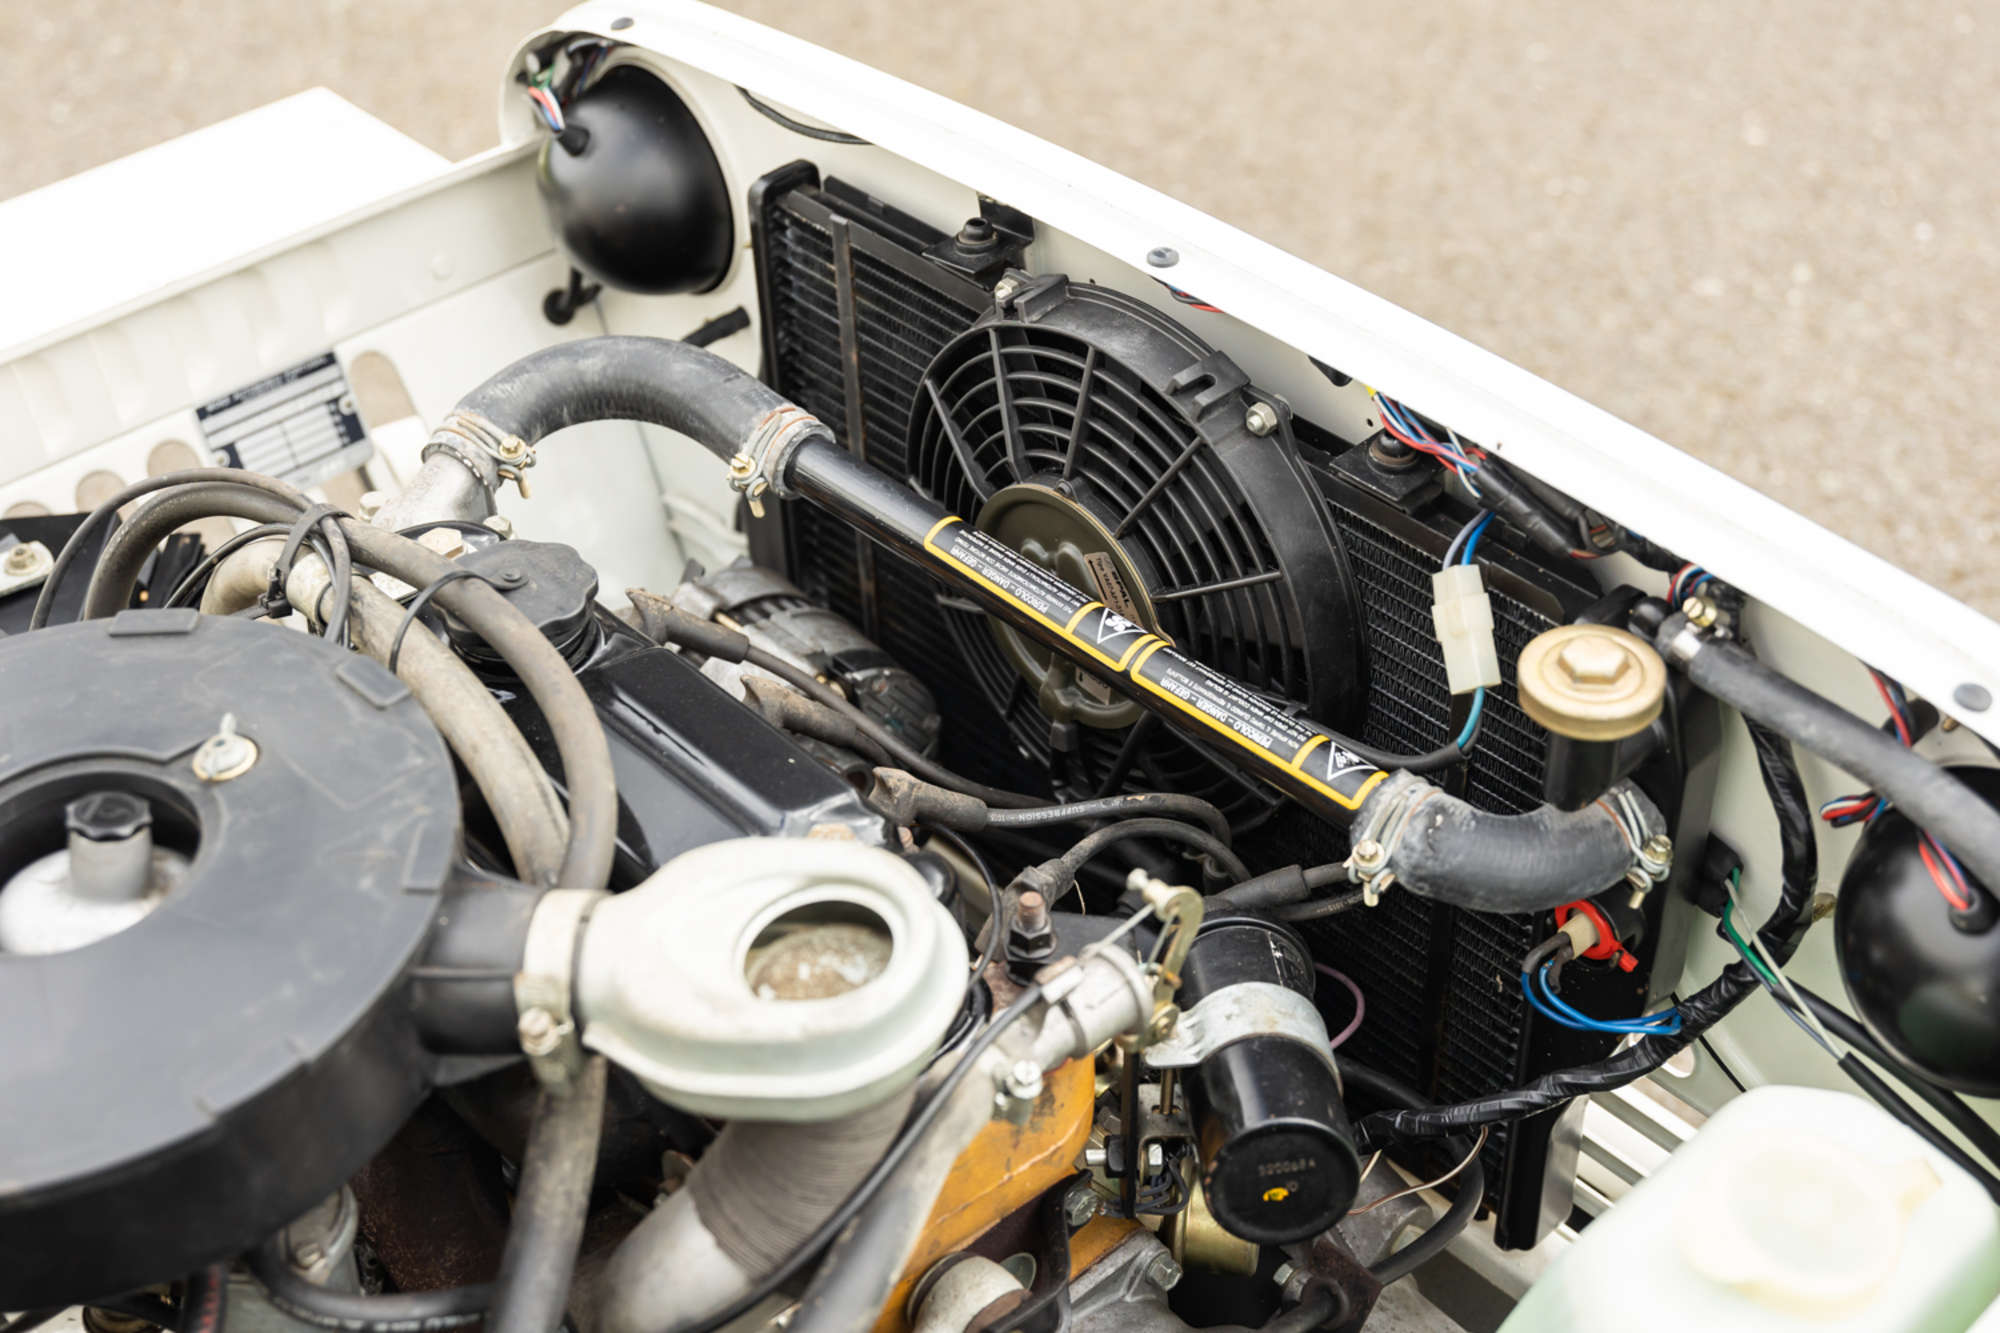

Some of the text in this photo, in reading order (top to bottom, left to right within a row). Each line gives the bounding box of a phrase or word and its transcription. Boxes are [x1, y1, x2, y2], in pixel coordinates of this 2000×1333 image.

[949, 545, 978, 568] GEFAHR
[981, 566, 1010, 589] DANGER
[1013, 587, 1048, 613] PERICOLO
[1159, 676, 1191, 700] GEFAHR
[1195, 698, 1227, 722] DANGER
[1232, 719, 1272, 749] PERICOLO
[1018, 805, 1084, 821] SUPPRESSION
